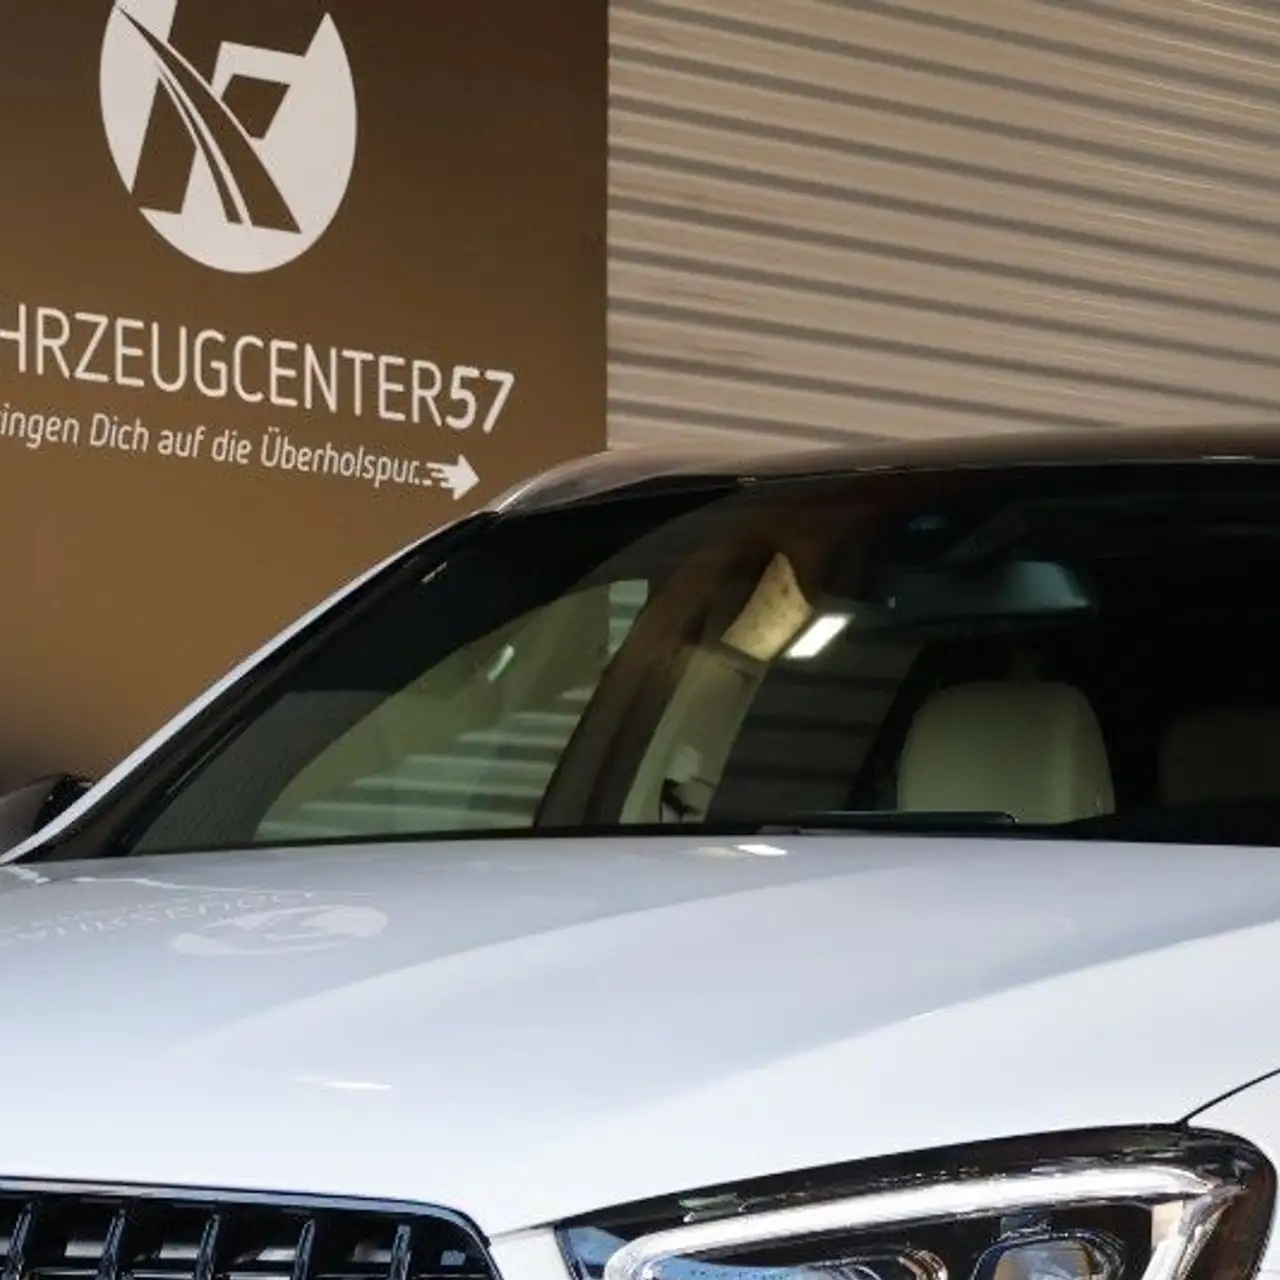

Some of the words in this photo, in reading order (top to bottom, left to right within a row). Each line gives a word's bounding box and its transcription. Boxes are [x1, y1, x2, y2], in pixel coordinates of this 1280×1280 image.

[89, 412, 150, 453] Dich
[157, 425, 206, 458] auf
[211, 427, 252, 465] die
